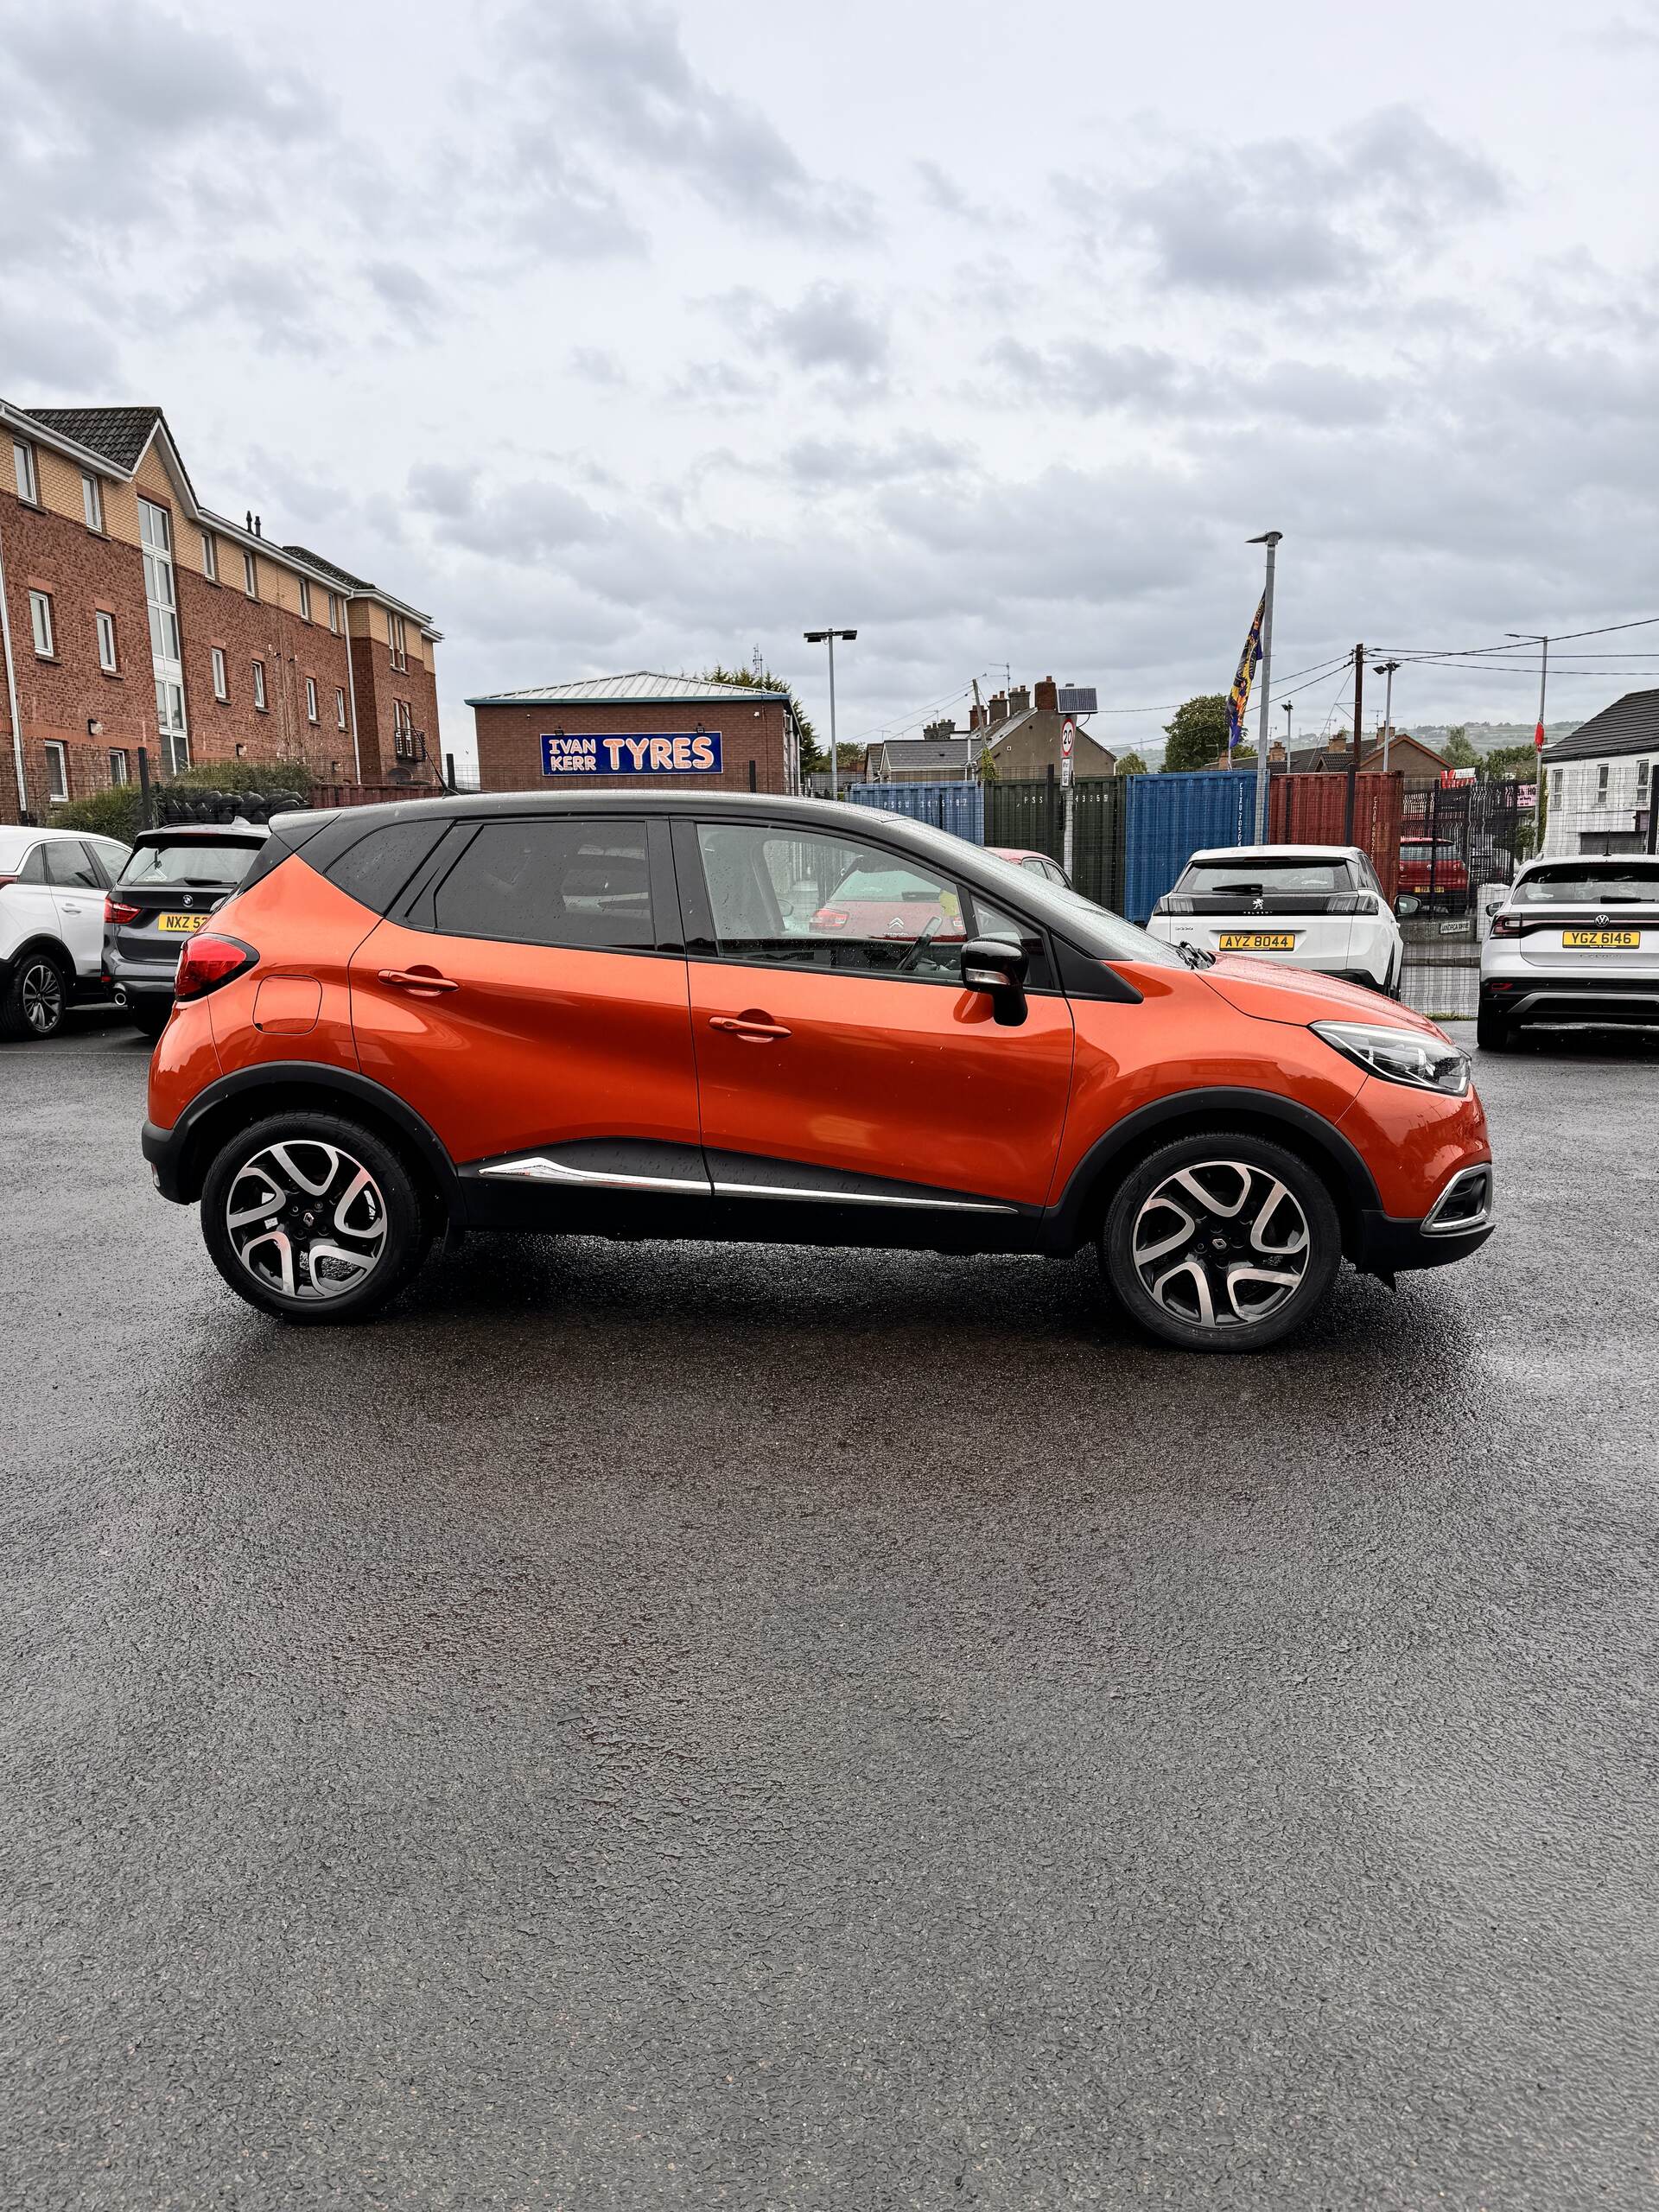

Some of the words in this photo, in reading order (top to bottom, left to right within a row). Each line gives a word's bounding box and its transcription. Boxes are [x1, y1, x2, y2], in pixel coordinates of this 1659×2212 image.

[1063, 729, 1072, 744] 20
[549, 739, 596, 754] IVAN
[602, 736, 715, 771] TYRES
[550, 756, 596, 771] KERR
[166, 916, 189, 929] NXZ
[1225, 936, 1250, 947] AYZ
[1254, 936, 1288, 947] 8044
[1572, 932, 1598, 944] YGZ
[1601, 932, 1631, 944] 6146
